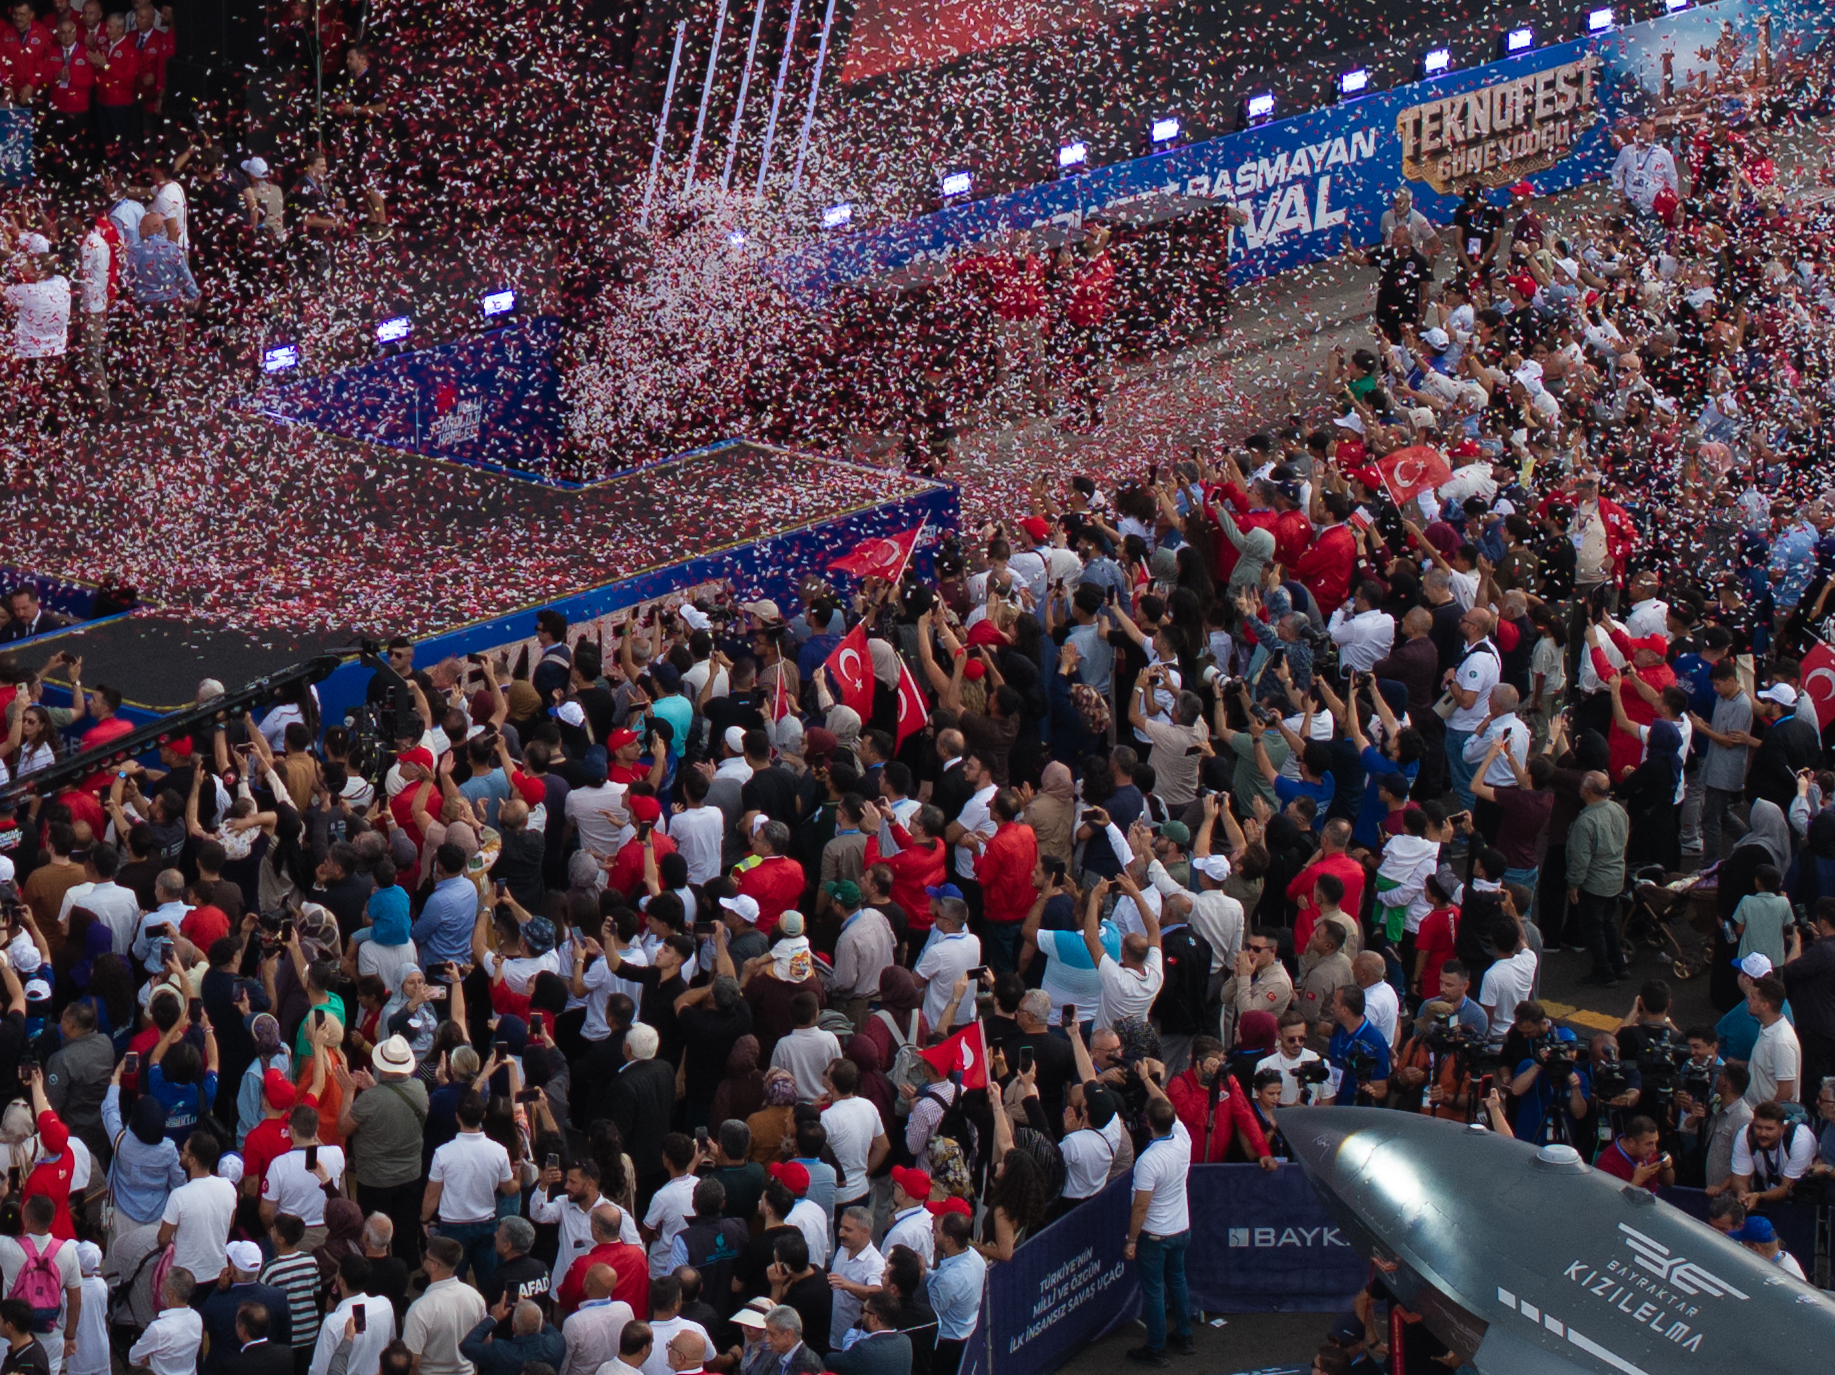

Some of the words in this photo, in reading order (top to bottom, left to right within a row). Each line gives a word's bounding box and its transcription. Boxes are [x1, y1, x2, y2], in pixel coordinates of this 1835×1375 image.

[1400, 64, 1598, 159] TEKNOFEST
[1254, 1226, 1352, 1247] BAYK
[518, 1276, 551, 1298] AFAD
[1039, 1246, 1094, 1291] TÜRKİYE'NİN
[1606, 1259, 1702, 1318] BAYRAKTAR
[1009, 1334, 1025, 1354] İLK
[1025, 1304, 1067, 1342] İNSANSIZ
[1067, 1285, 1096, 1316] SAVAŞ
[1097, 1262, 1125, 1293] UÇAĞI
[1032, 1290, 1057, 1319] MİLLİ
[1057, 1283, 1069, 1301] VE
[1563, 1259, 1704, 1353] KIZILELMA
